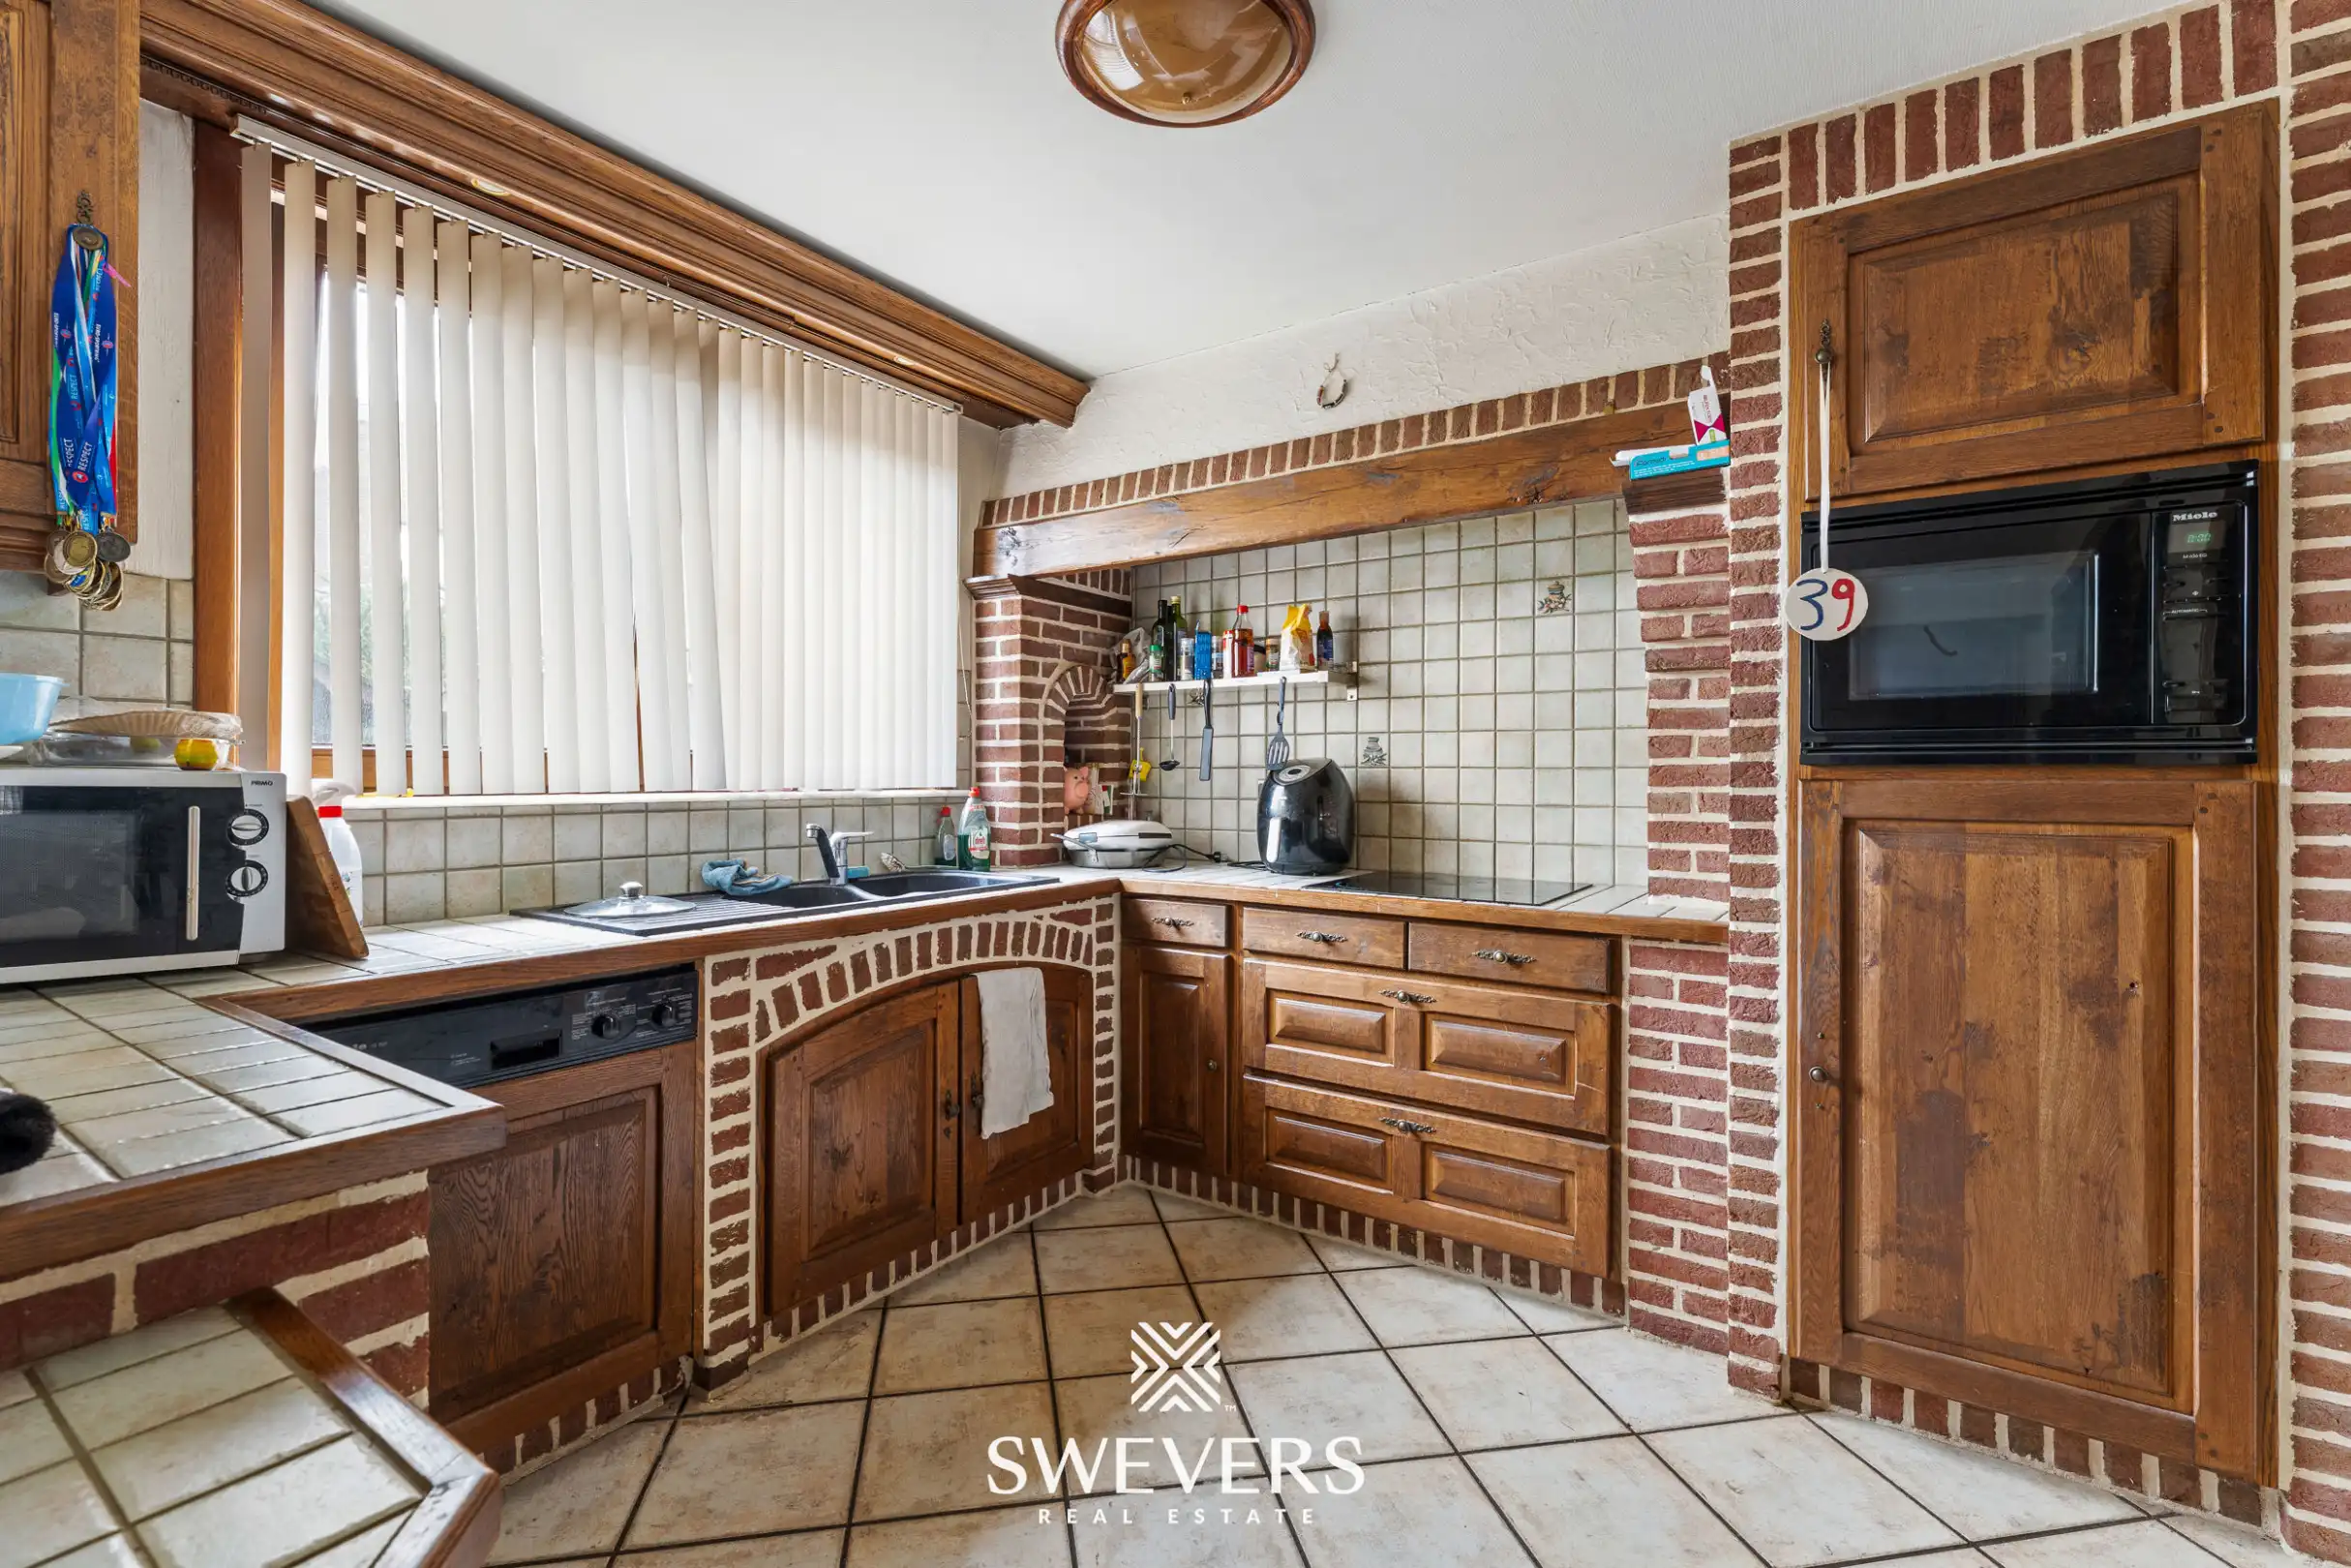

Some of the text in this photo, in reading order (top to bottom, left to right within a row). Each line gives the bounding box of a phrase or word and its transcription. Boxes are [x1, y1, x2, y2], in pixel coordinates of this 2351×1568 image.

[77, 441, 93, 471] RESPECT
[2173, 511, 2218, 522] Miele
[1796, 578, 1855, 632] 39
